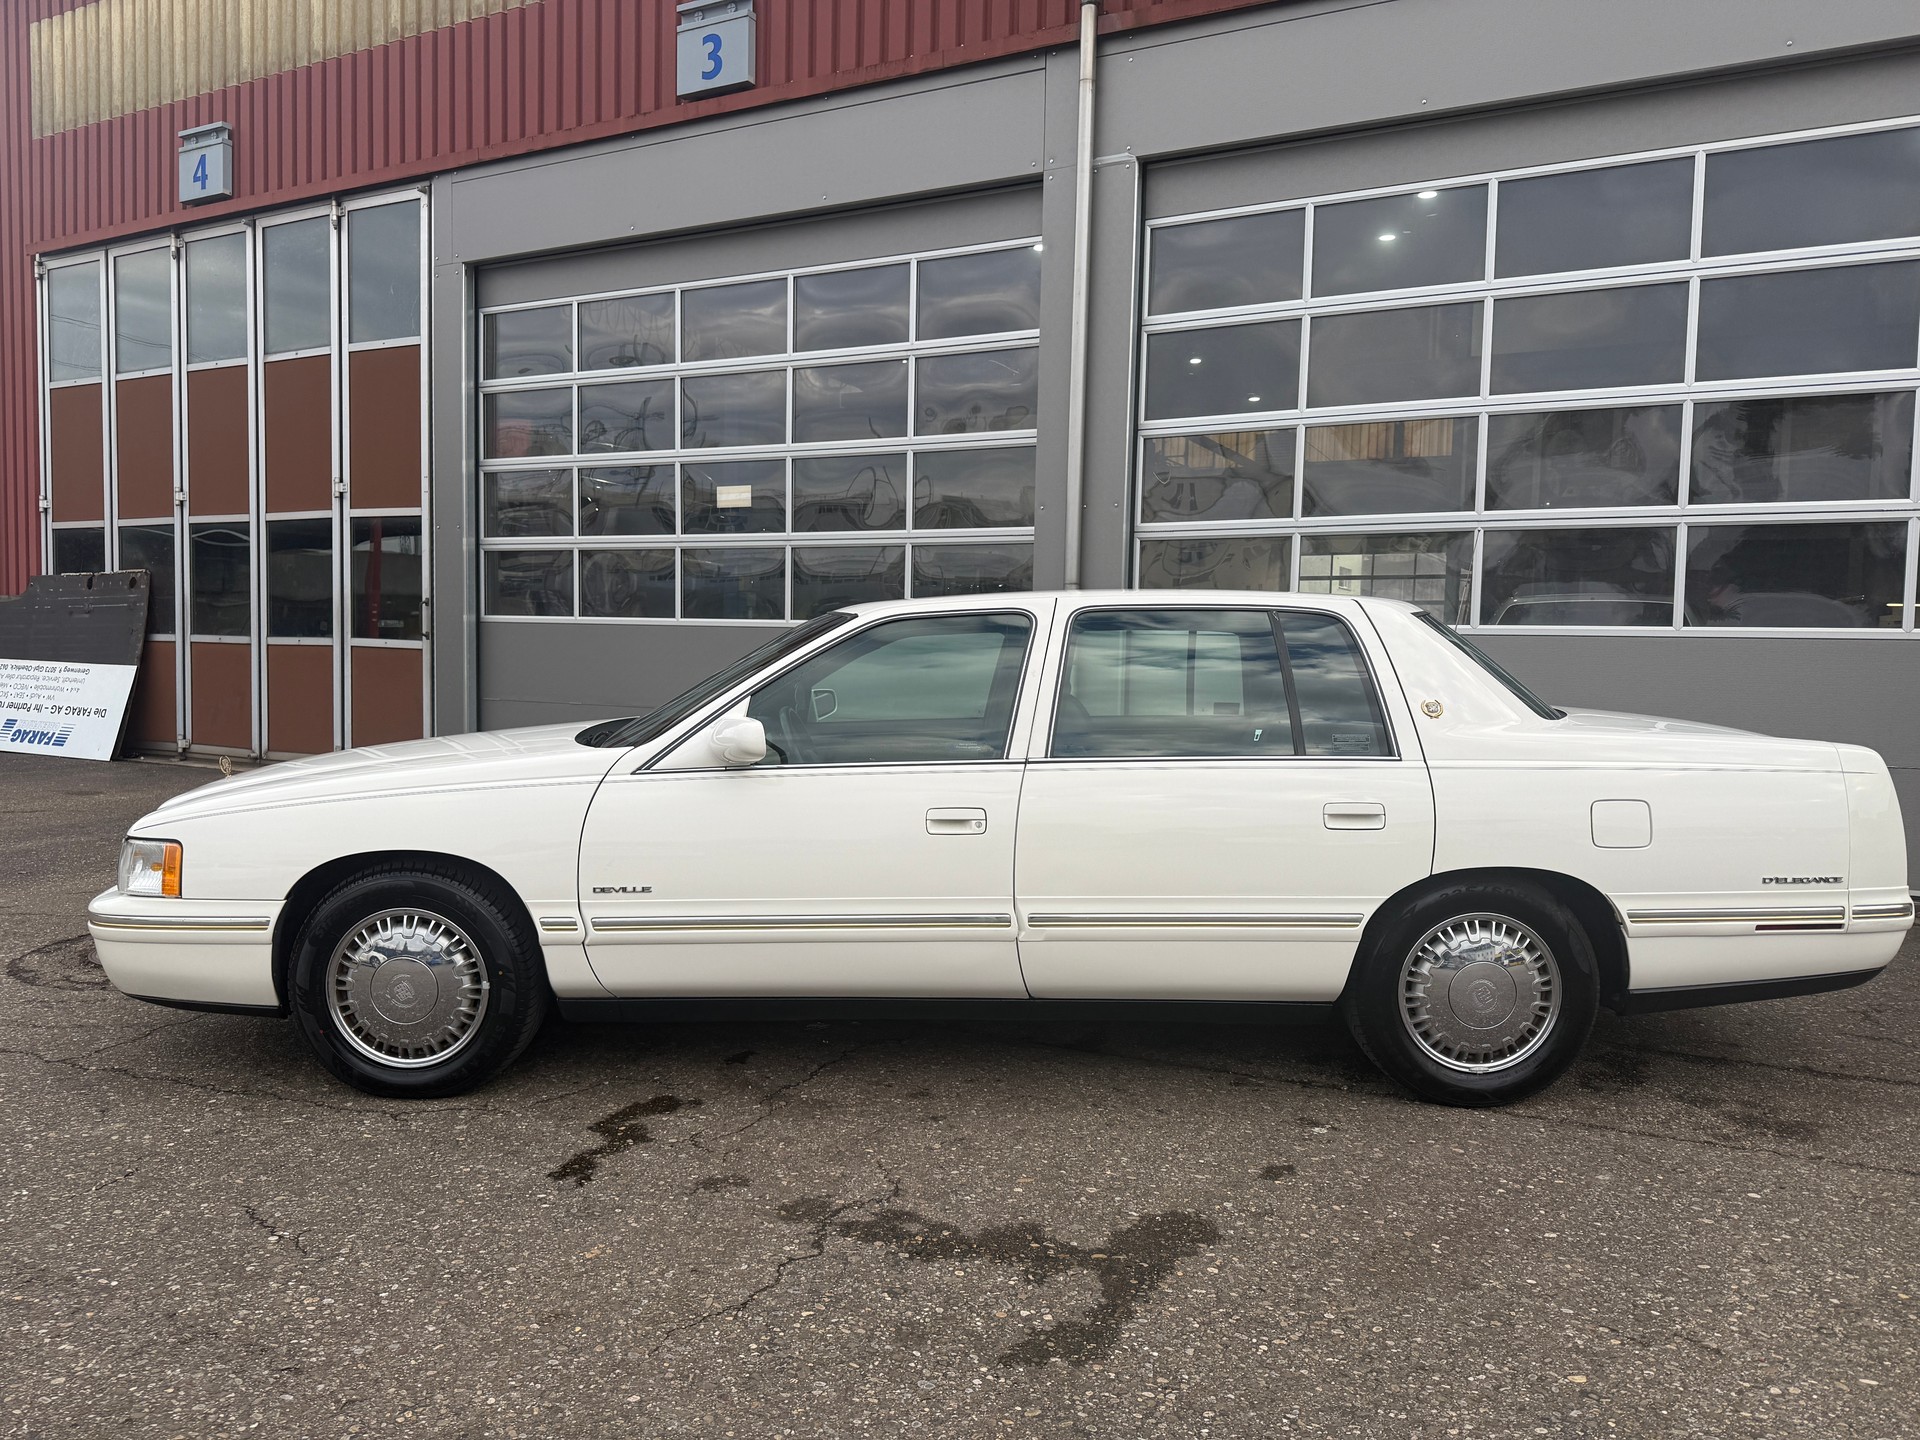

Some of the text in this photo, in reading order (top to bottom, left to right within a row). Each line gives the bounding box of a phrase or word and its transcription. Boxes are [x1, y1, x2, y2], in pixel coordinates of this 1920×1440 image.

[701, 33, 723, 80] 3
[192, 153, 208, 190] 4
[6, 701, 32, 712] Partner
[33, 703, 44, 713] Ihr
[50, 704, 64, 714] AG
[64, 705, 92, 717] FARAG
[93, 707, 107, 718] Die
[10, 728, 56, 745] FARAG
